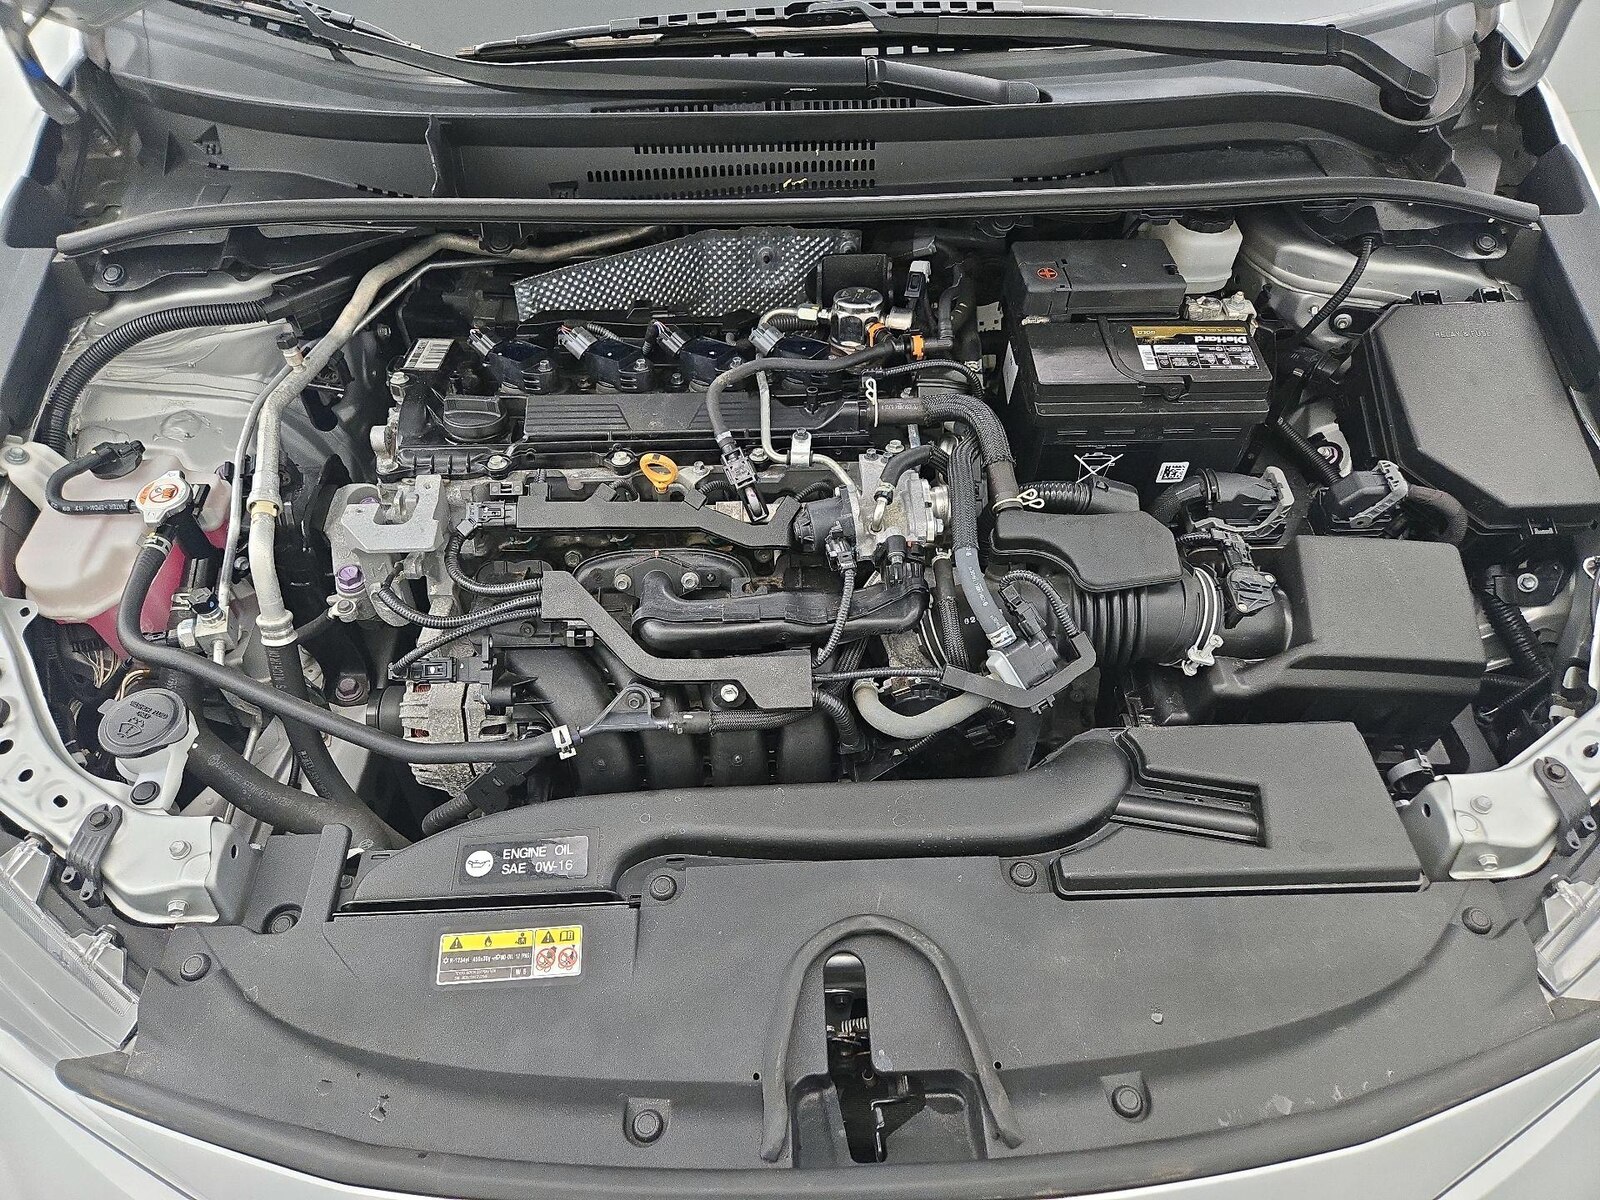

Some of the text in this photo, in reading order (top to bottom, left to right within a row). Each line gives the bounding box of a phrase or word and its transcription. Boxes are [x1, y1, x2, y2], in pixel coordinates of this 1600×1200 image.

[1194, 335, 1247, 345] DieHard
[503, 844, 574, 860] ENGINE OIL
[501, 859, 573, 875] SAE 0W-16
